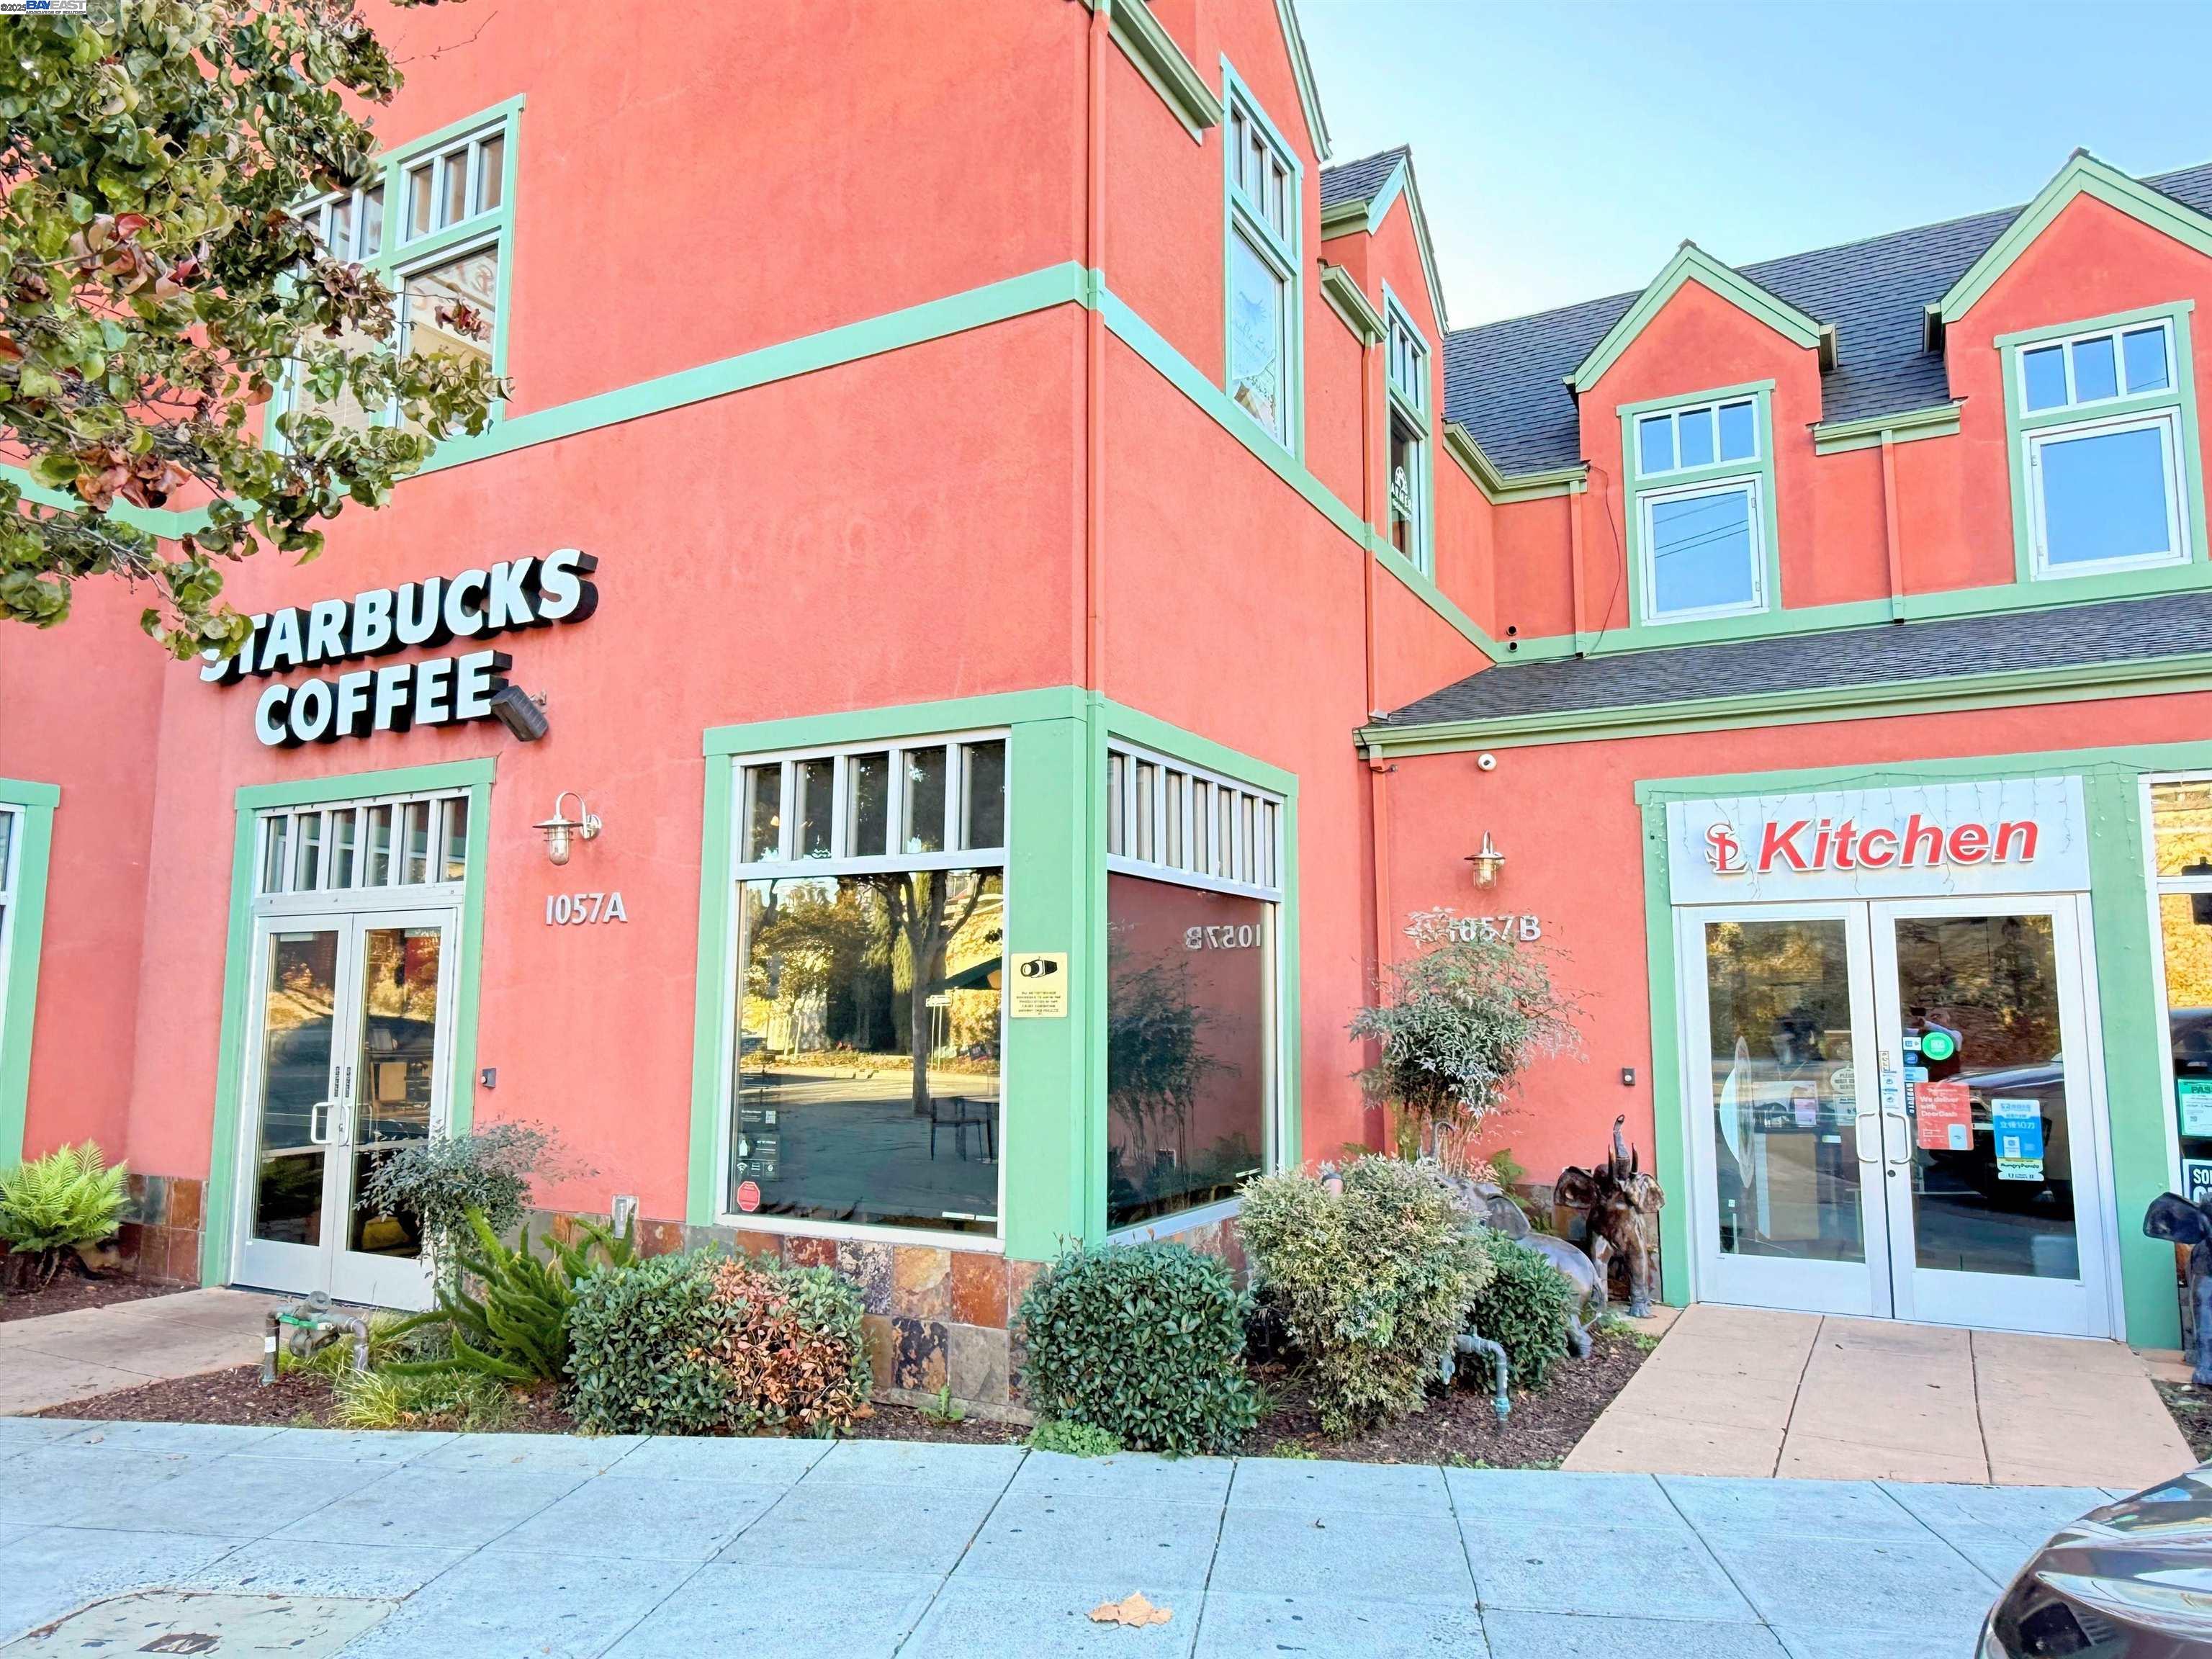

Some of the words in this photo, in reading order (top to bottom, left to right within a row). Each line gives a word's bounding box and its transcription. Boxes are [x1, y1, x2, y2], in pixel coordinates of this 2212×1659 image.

[255, 649, 508, 746] COFFEE
[1758, 812, 2039, 873] Kitchen
[546, 892, 628, 925] 1057A
